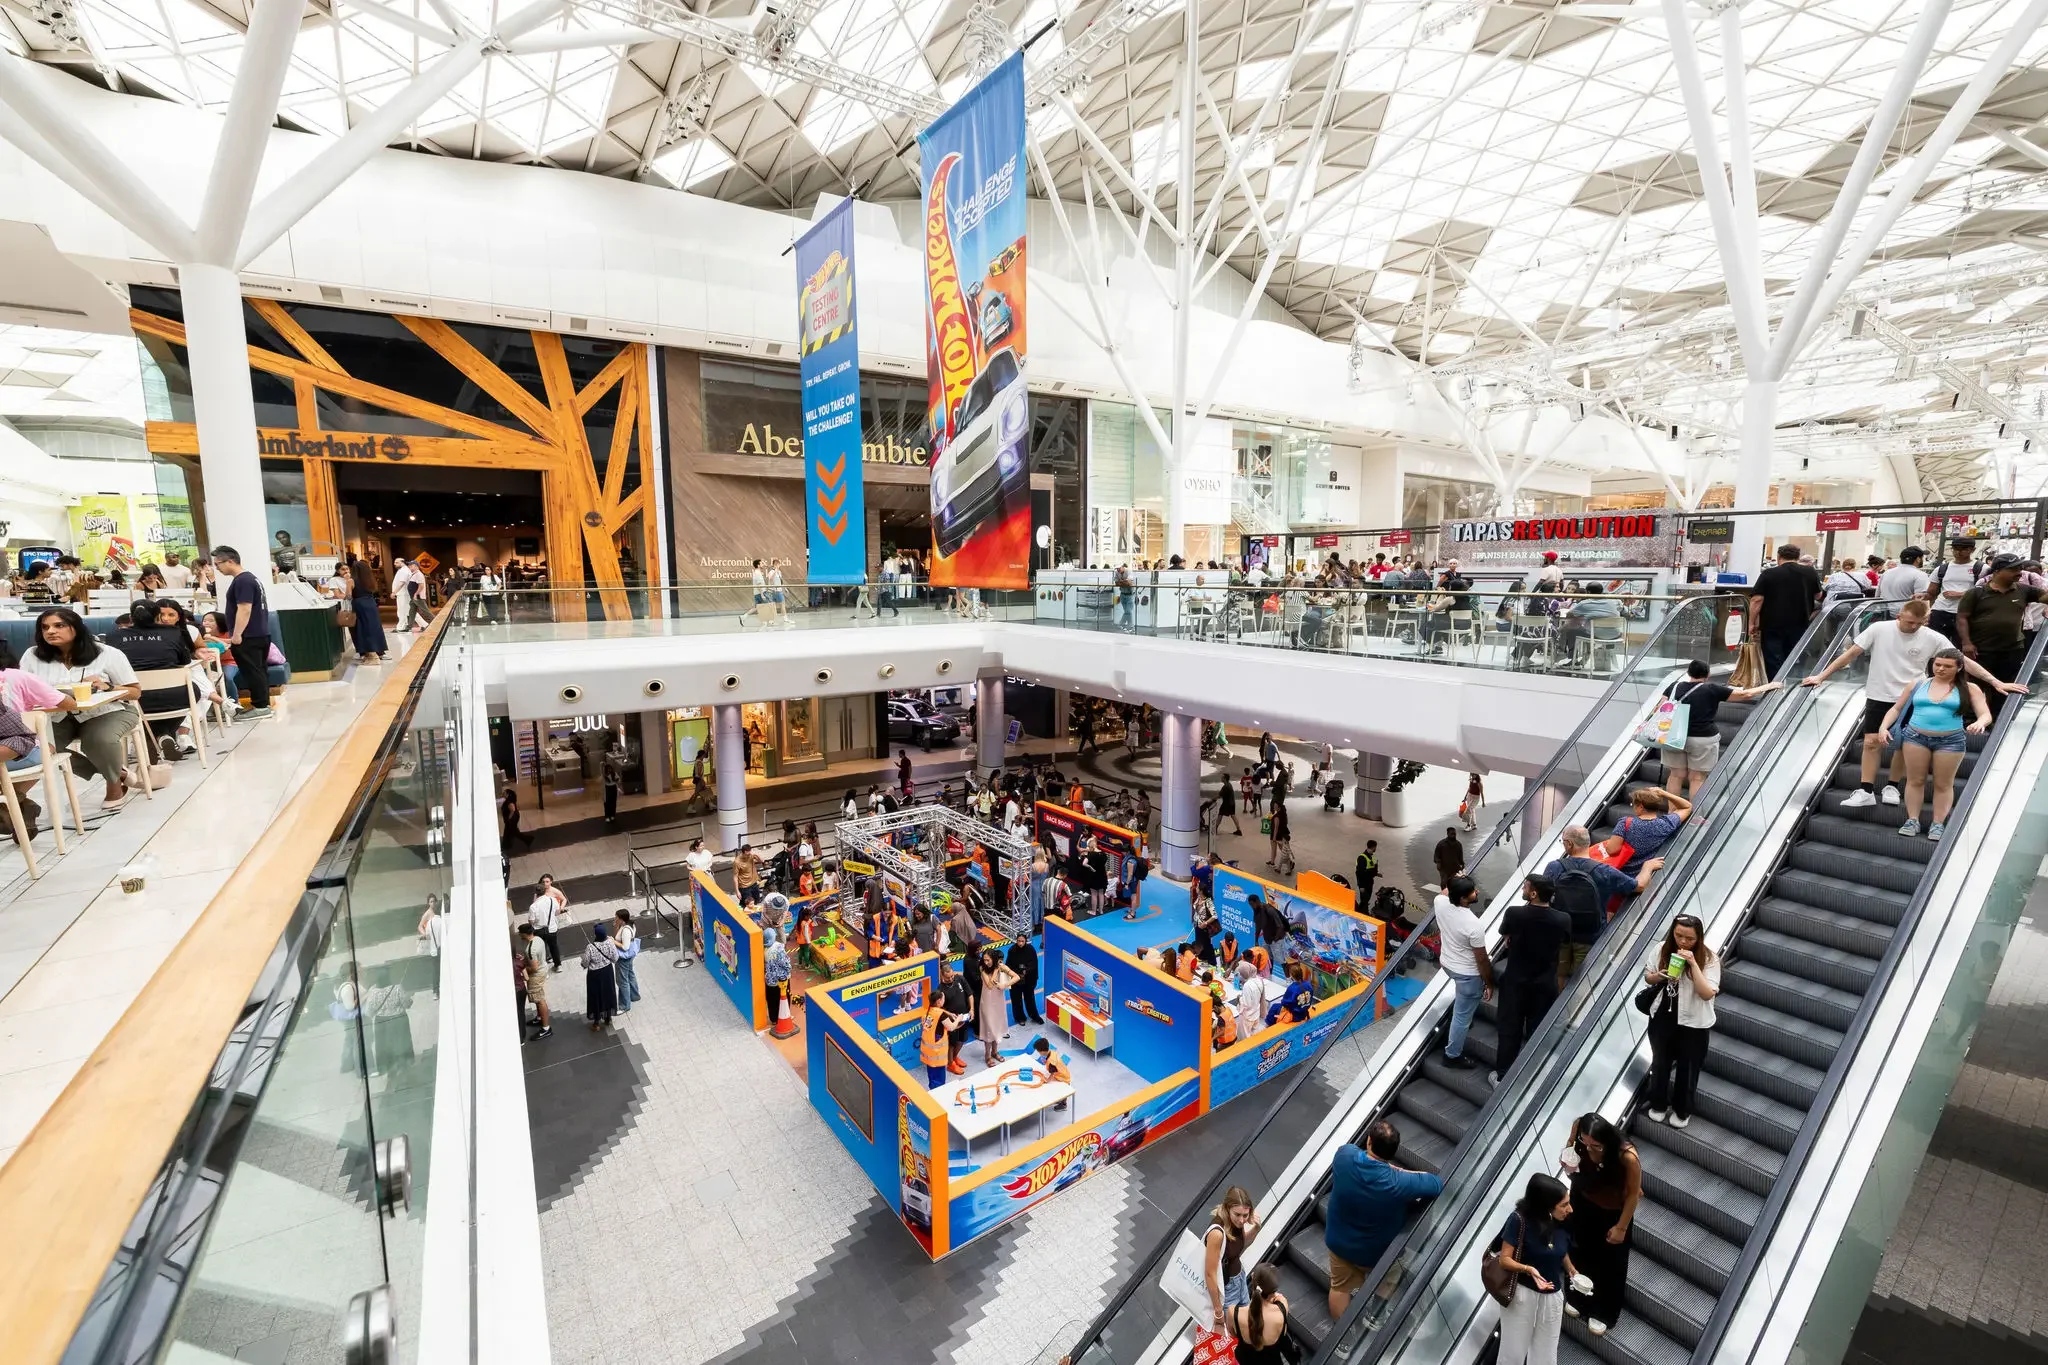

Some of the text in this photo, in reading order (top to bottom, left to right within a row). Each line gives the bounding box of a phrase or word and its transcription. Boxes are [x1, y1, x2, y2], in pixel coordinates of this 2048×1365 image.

[954, 153, 1017, 224] CHALLENGE
[811, 286, 840, 315] TESTING
[812, 304, 839, 332] CENTRE
[805, 393, 855, 422] WILL YOU TAKE ON
[808, 411, 853, 437] THE CHALLENGE?
[257, 430, 376, 459] imberland
[1184, 478, 1220, 491] OYSHO
[102, 520, 118, 534] CITY
[1824, 517, 1852, 526] SANGRIA
[700, 556, 754, 567] Abercrombi
[1472, 550, 1618, 560] SPANISH BAR AN ESTAURANT
[711, 569, 754, 579] abercrom
[573, 714, 609, 732] JUUL
[1046, 815, 1072, 830] RACE ROOM
[1222, 910, 1253, 927] PROBLEM
[1222, 917, 1250, 934] SOLVING
[850, 970, 917, 996] ENGINEERING ZONE
[1127, 999, 1170, 1022] TRACK CREATOR
[1028, 1161, 1057, 1195] HOT
[1176, 1256, 1209, 1291] PRIMA
[1212, 1336, 1233, 1352] Bsk
